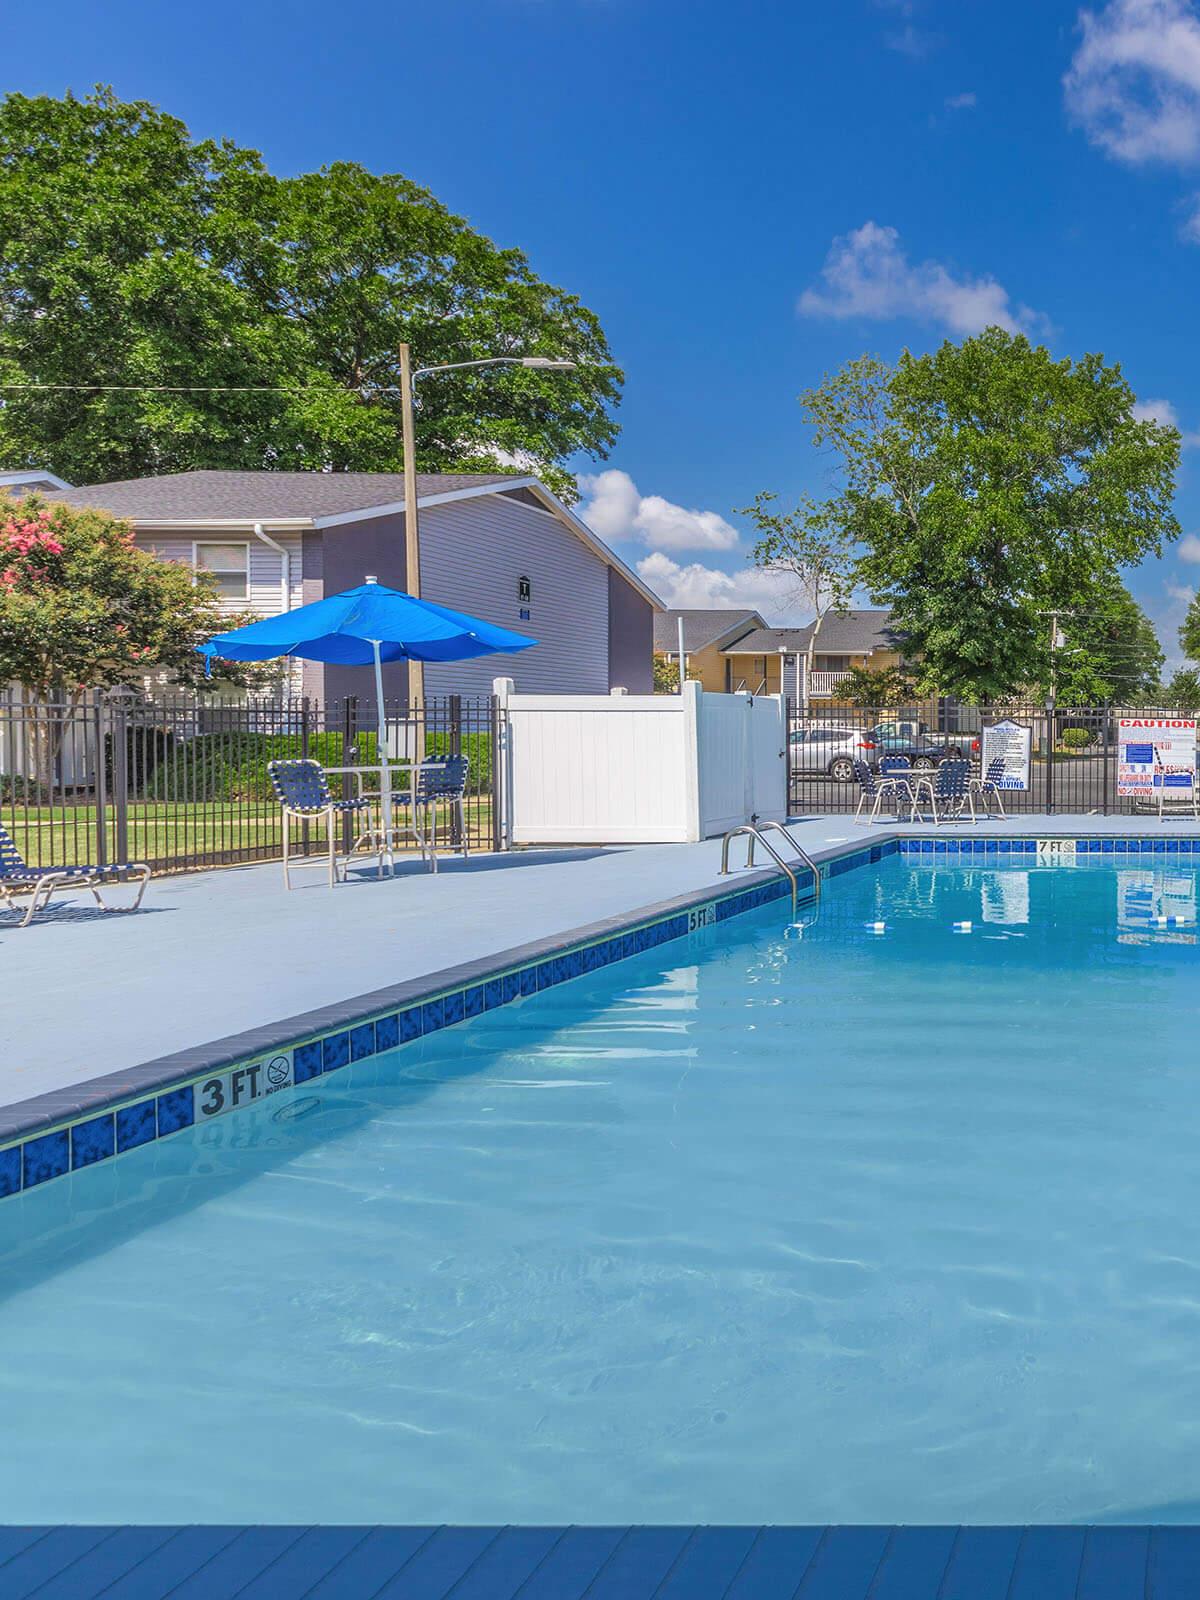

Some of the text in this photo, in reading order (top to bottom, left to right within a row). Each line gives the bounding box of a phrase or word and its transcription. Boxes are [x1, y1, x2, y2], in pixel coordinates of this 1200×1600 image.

[1120, 720, 1195, 728] CAUTION
[998, 781, 1024, 789] DIVING
[1040, 841, 1048, 852] 7
[690, 911, 696, 931] 5
[202, 1063, 261, 1115] 3 FT.
